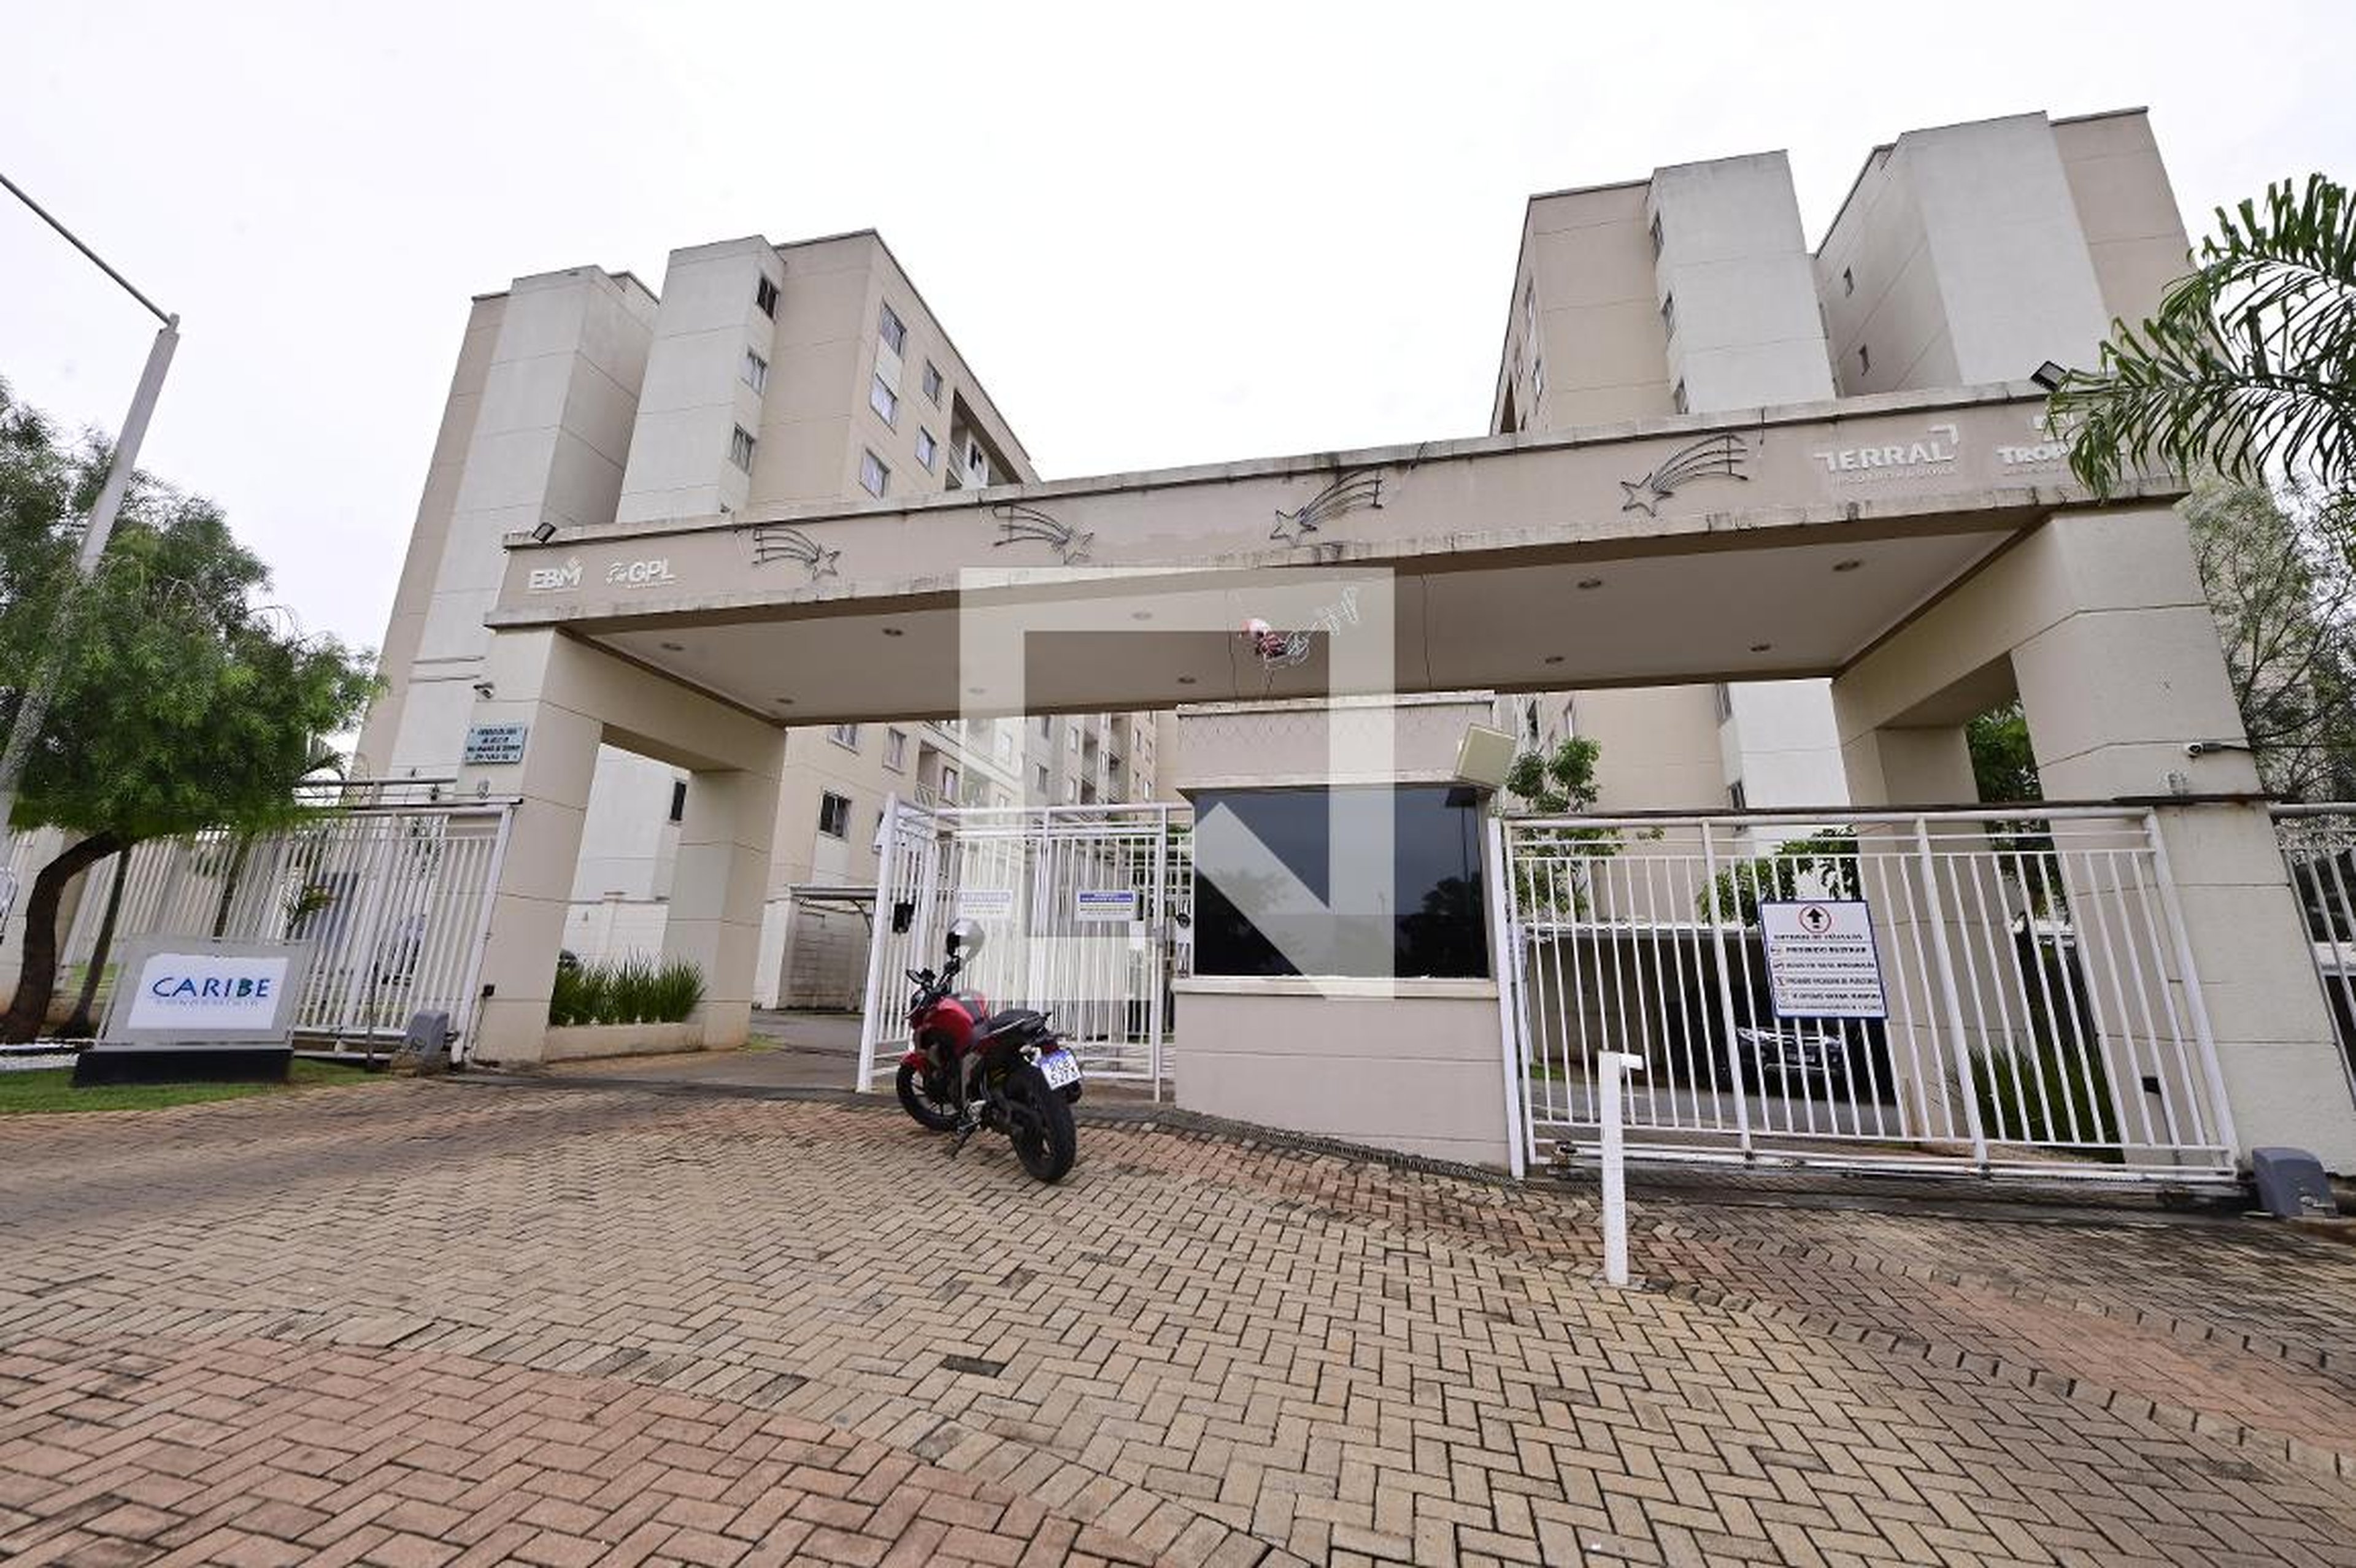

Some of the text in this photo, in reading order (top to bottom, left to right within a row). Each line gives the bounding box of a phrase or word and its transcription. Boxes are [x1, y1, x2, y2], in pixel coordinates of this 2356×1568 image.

[1813, 441, 1956, 472] TERRAL
[528, 567, 583, 590] EBM
[628, 558, 676, 582] GPL
[153, 977, 270, 997] CARIBE
